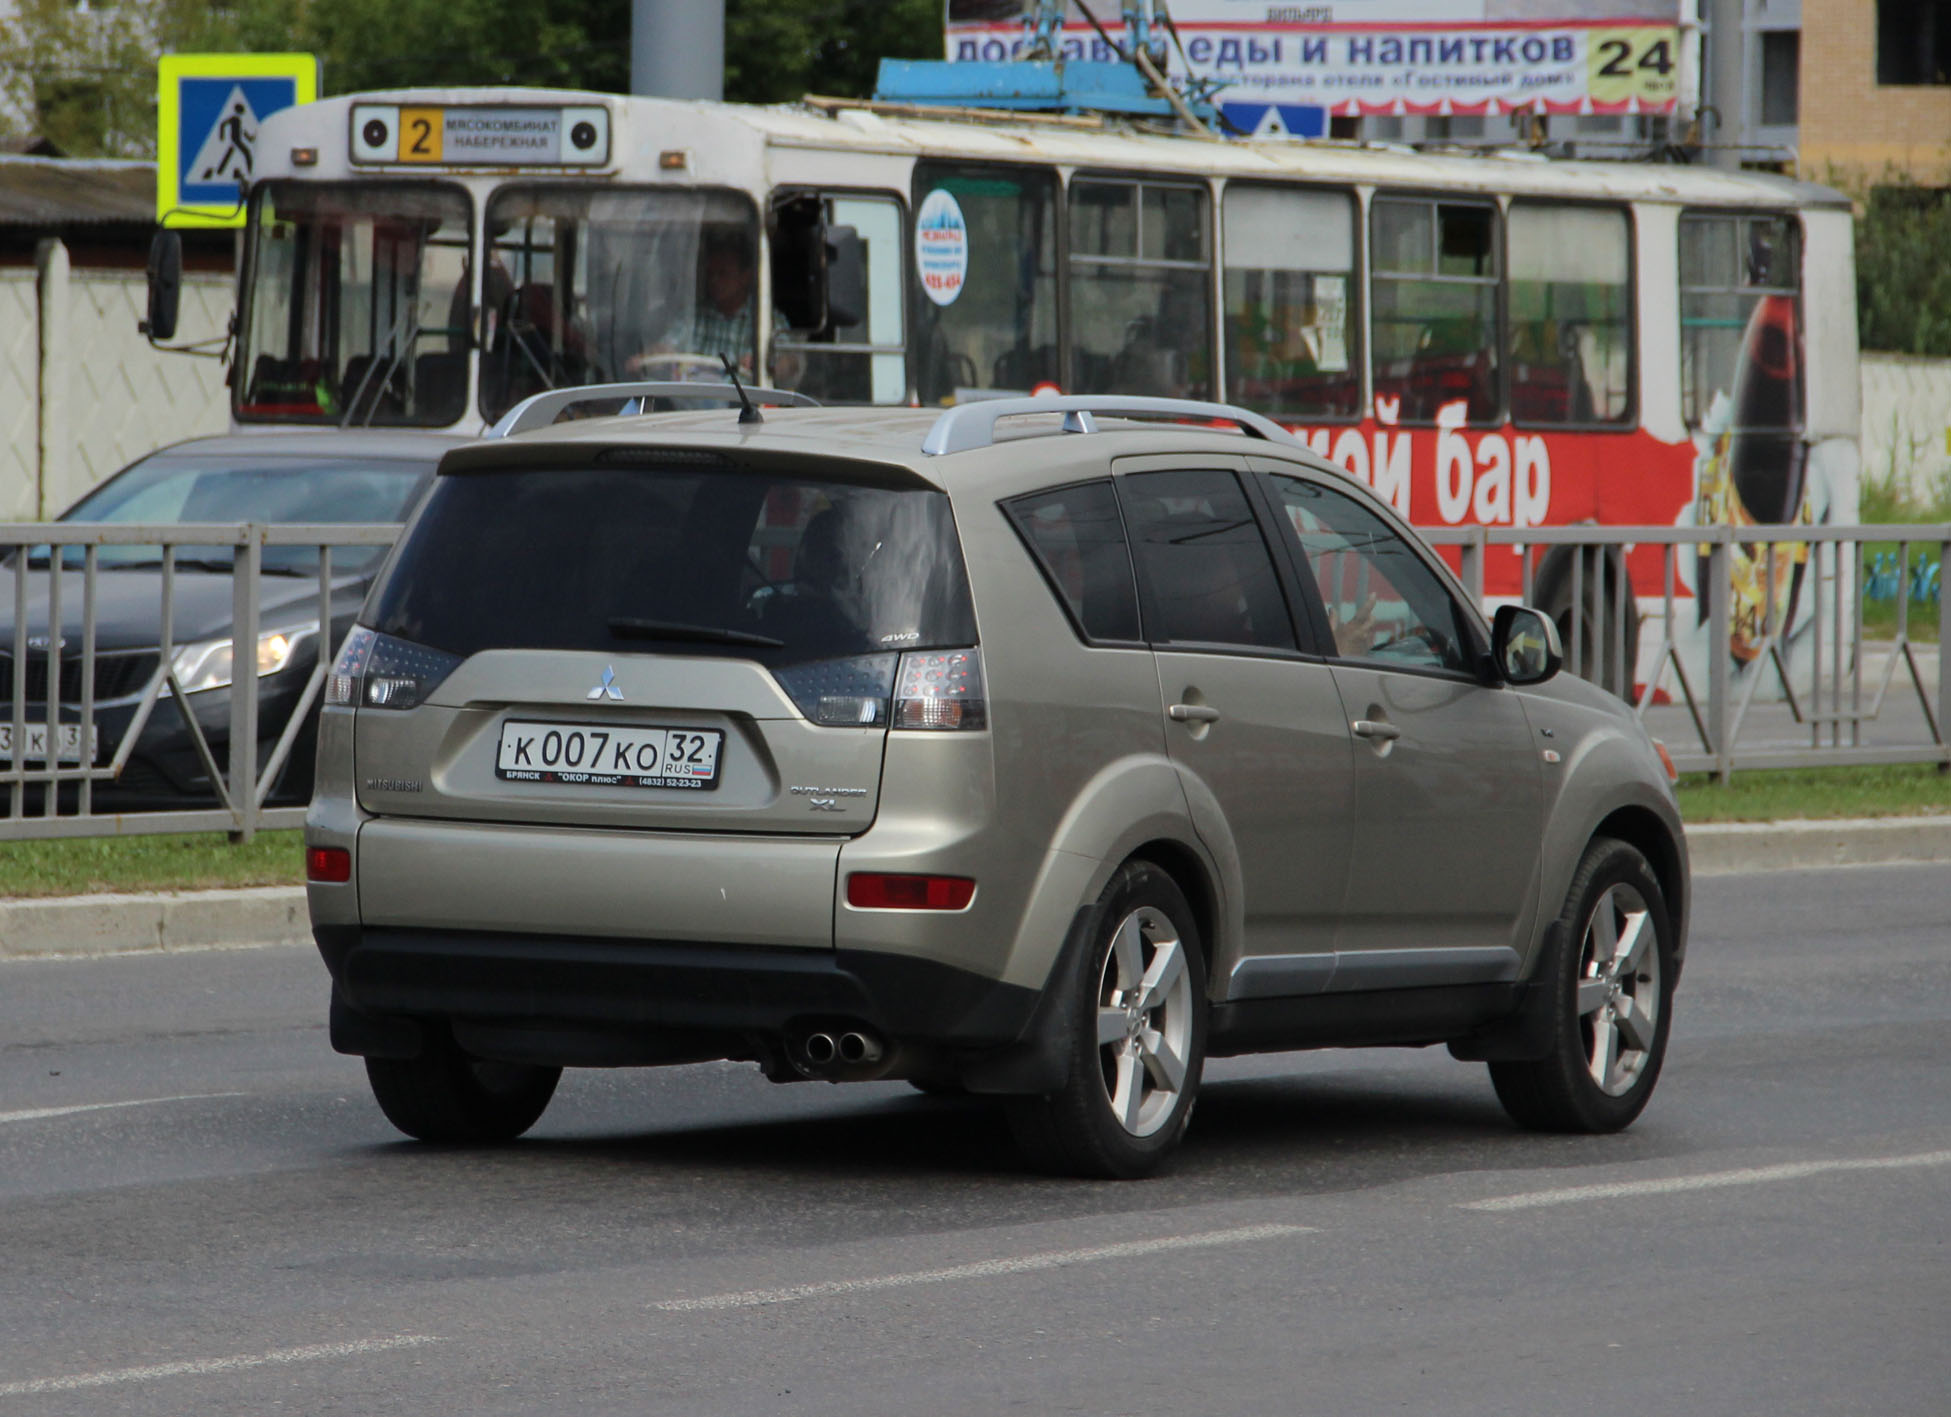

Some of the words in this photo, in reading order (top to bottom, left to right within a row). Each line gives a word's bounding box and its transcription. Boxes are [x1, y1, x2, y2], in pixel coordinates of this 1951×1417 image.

[1188, 36, 1281, 70] еды
[1303, 35, 1328, 64] и
[1348, 34, 1576, 66] напитков
[1598, 40, 1674, 77] 24
[446, 119, 557, 133] МЯСОКОМБИНАТ
[410, 119, 431, 154] 2
[455, 136, 548, 149] НАБЕРЕЖНАЯ
[1435, 401, 1551, 555] бар
[881, 632, 920, 642] 4WD
[669, 734, 706, 763] 32
[664, 763, 691, 775] RUS
[366, 778, 423, 793] MITSUBISHI
[506, 770, 541, 781] БРЯНСК
[557, 772, 589, 783] "ОКОР
[591, 774, 622, 785] плюс"
[639, 776, 665, 787] (4832)
[666, 778, 702, 789] 52-23-23
[790, 786, 867, 798] OUTLANDER
[809, 798, 847, 812] XL
